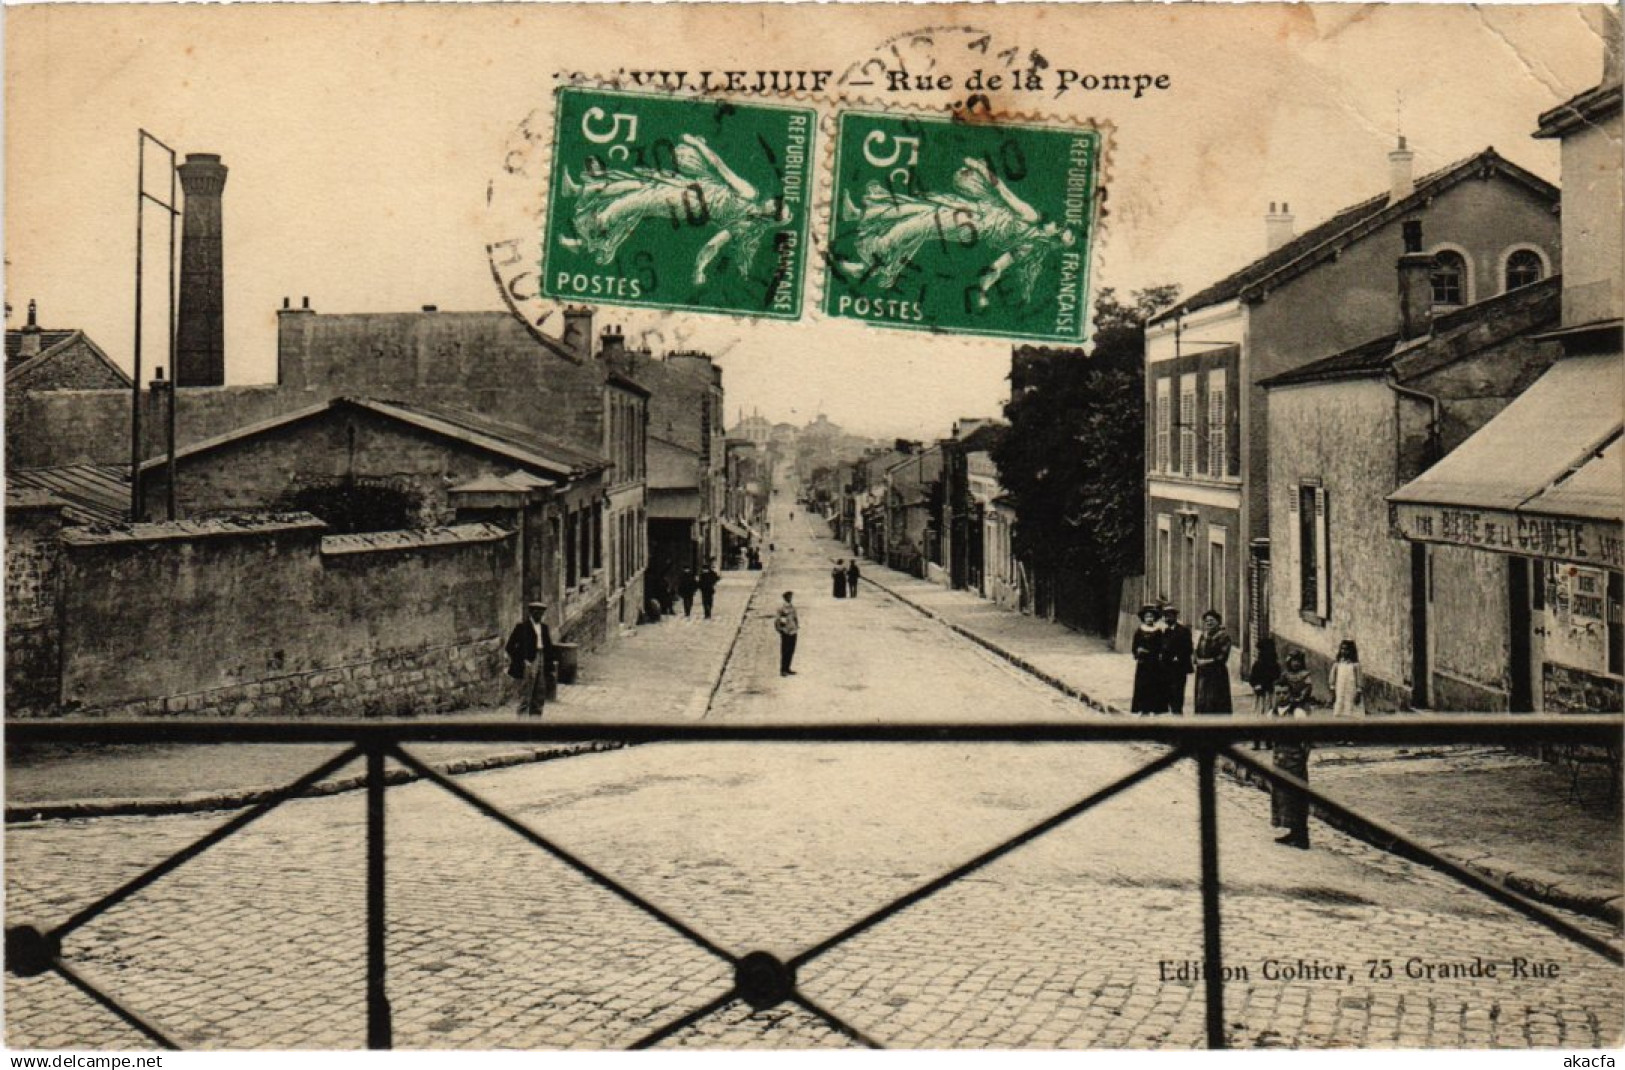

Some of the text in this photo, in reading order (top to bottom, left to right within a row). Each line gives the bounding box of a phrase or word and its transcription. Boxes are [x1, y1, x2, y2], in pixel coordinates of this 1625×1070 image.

[886, 69, 953, 91] Rue
[964, 68, 1003, 91] de
[1056, 69, 1171, 99] Pompe
[557, 271, 642, 299] POSTES
[838, 295, 924, 322] POSTES
[1158, 959, 1250, 983] Edion
[1366, 958, 1394, 980] 75
[1405, 956, 1498, 980] Grande
[1512, 956, 1561, 979] Rue
